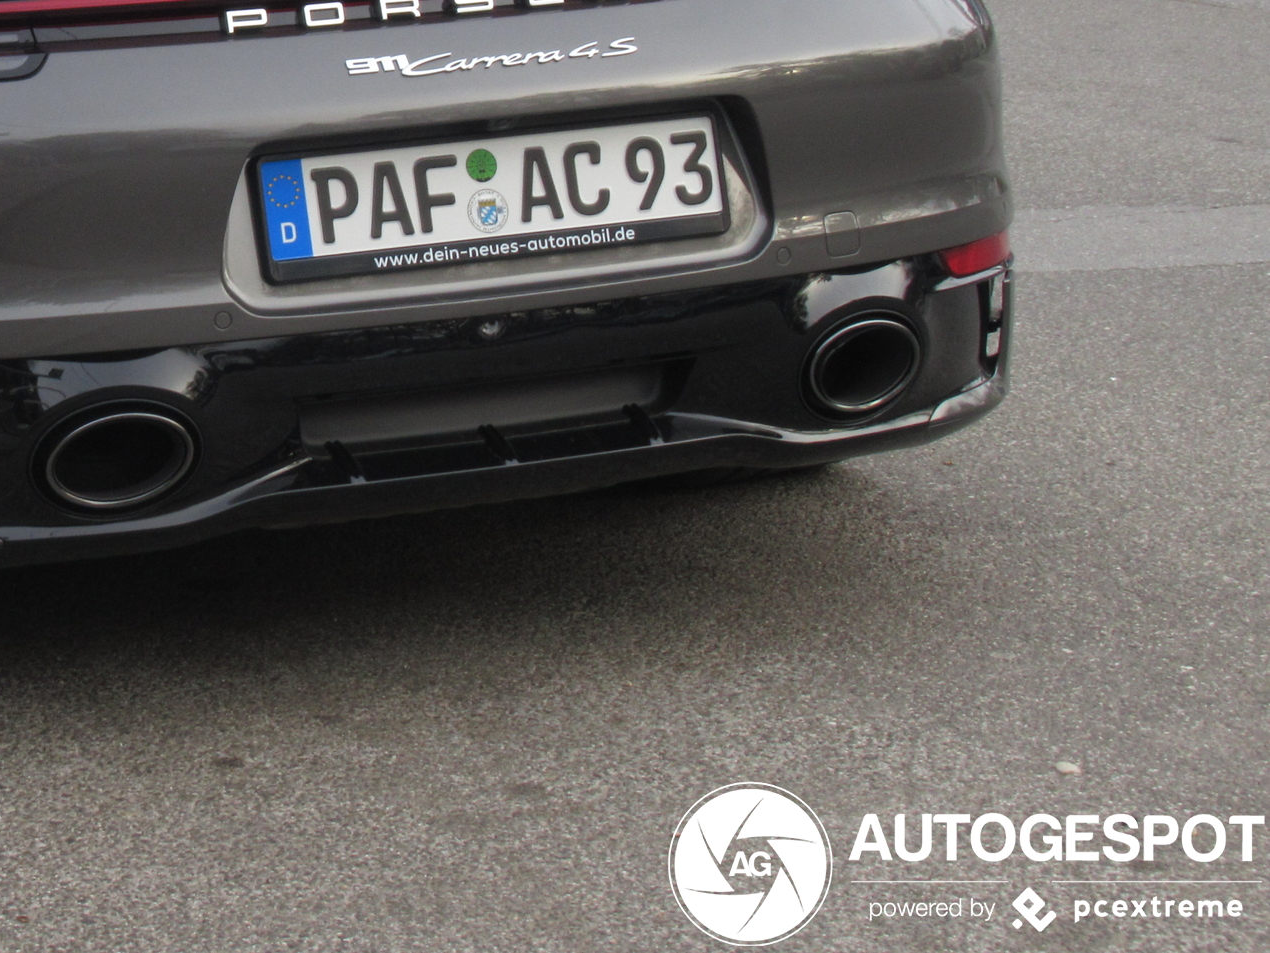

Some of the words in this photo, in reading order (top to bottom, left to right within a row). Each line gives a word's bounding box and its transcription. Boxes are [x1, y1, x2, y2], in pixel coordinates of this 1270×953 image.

[345, 54, 410, 76] 911
[401, 49, 565, 77] Carrera
[310, 154, 457, 244] PAF
[521, 140, 610, 223] AC
[625, 130, 713, 211] 93
[280, 222, 297, 244] D
[374, 226, 636, 269] www.dein-neues-automobil.de
